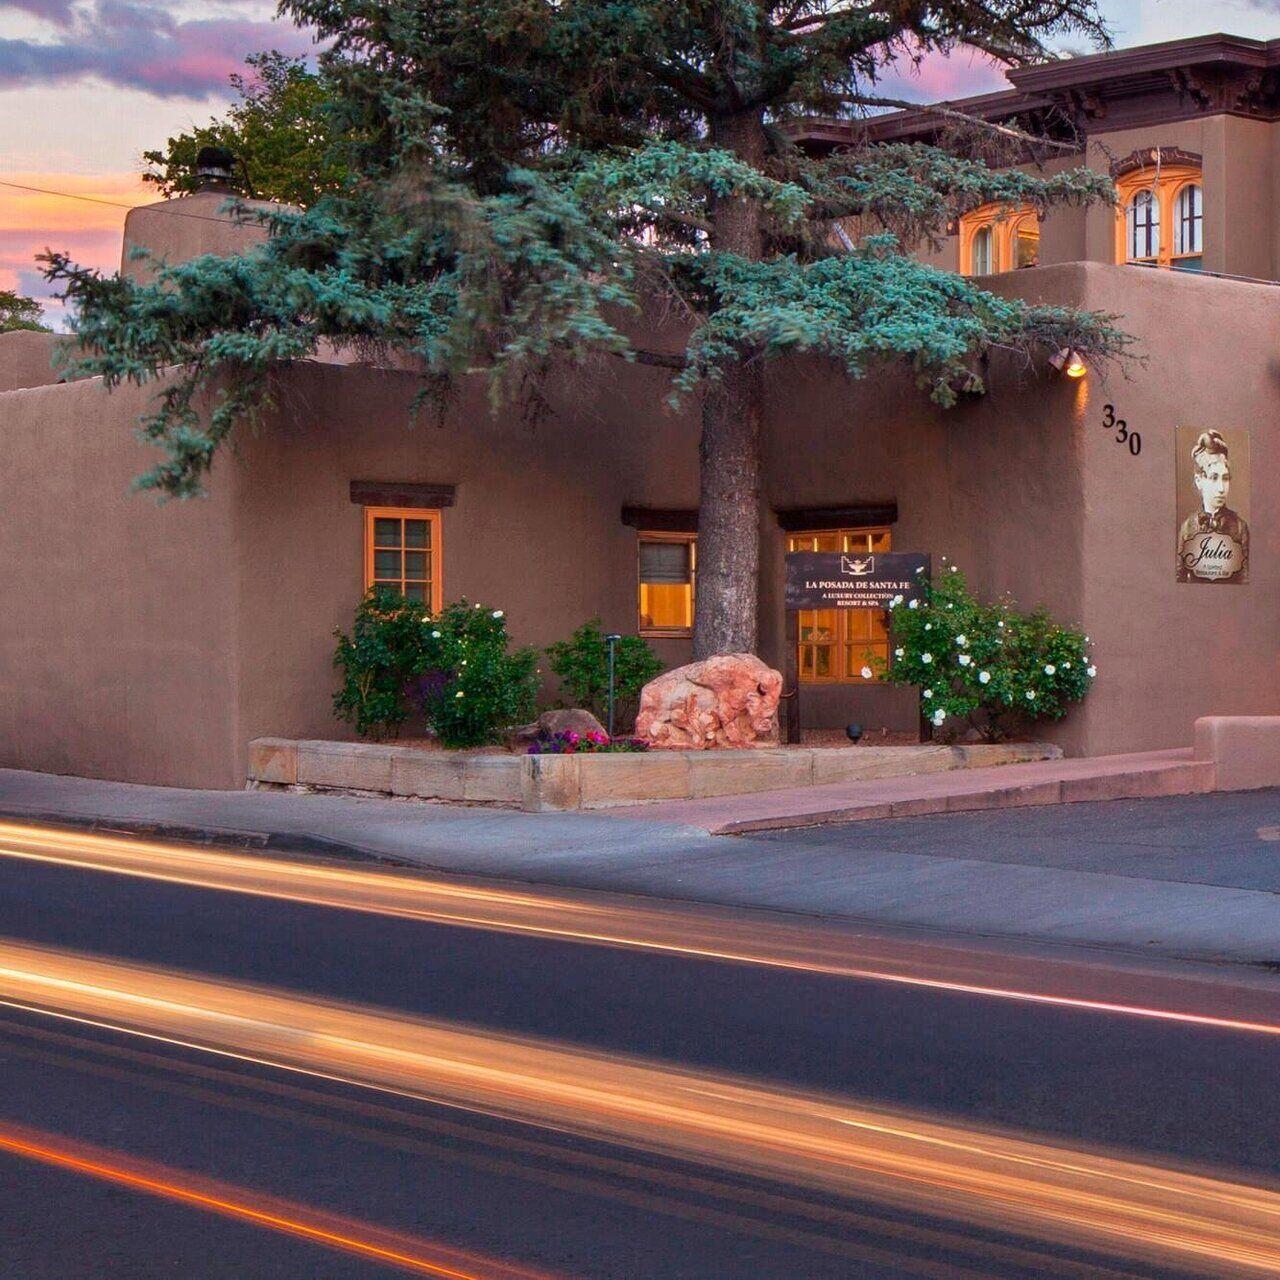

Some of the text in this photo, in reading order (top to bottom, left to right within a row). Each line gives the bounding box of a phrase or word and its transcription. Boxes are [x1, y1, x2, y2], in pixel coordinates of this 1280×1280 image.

[1102, 404, 1142, 456] 330
[1184, 536, 1233, 568] Julia
[805, 581, 910, 589] LA POSADA DE SANTA FE
